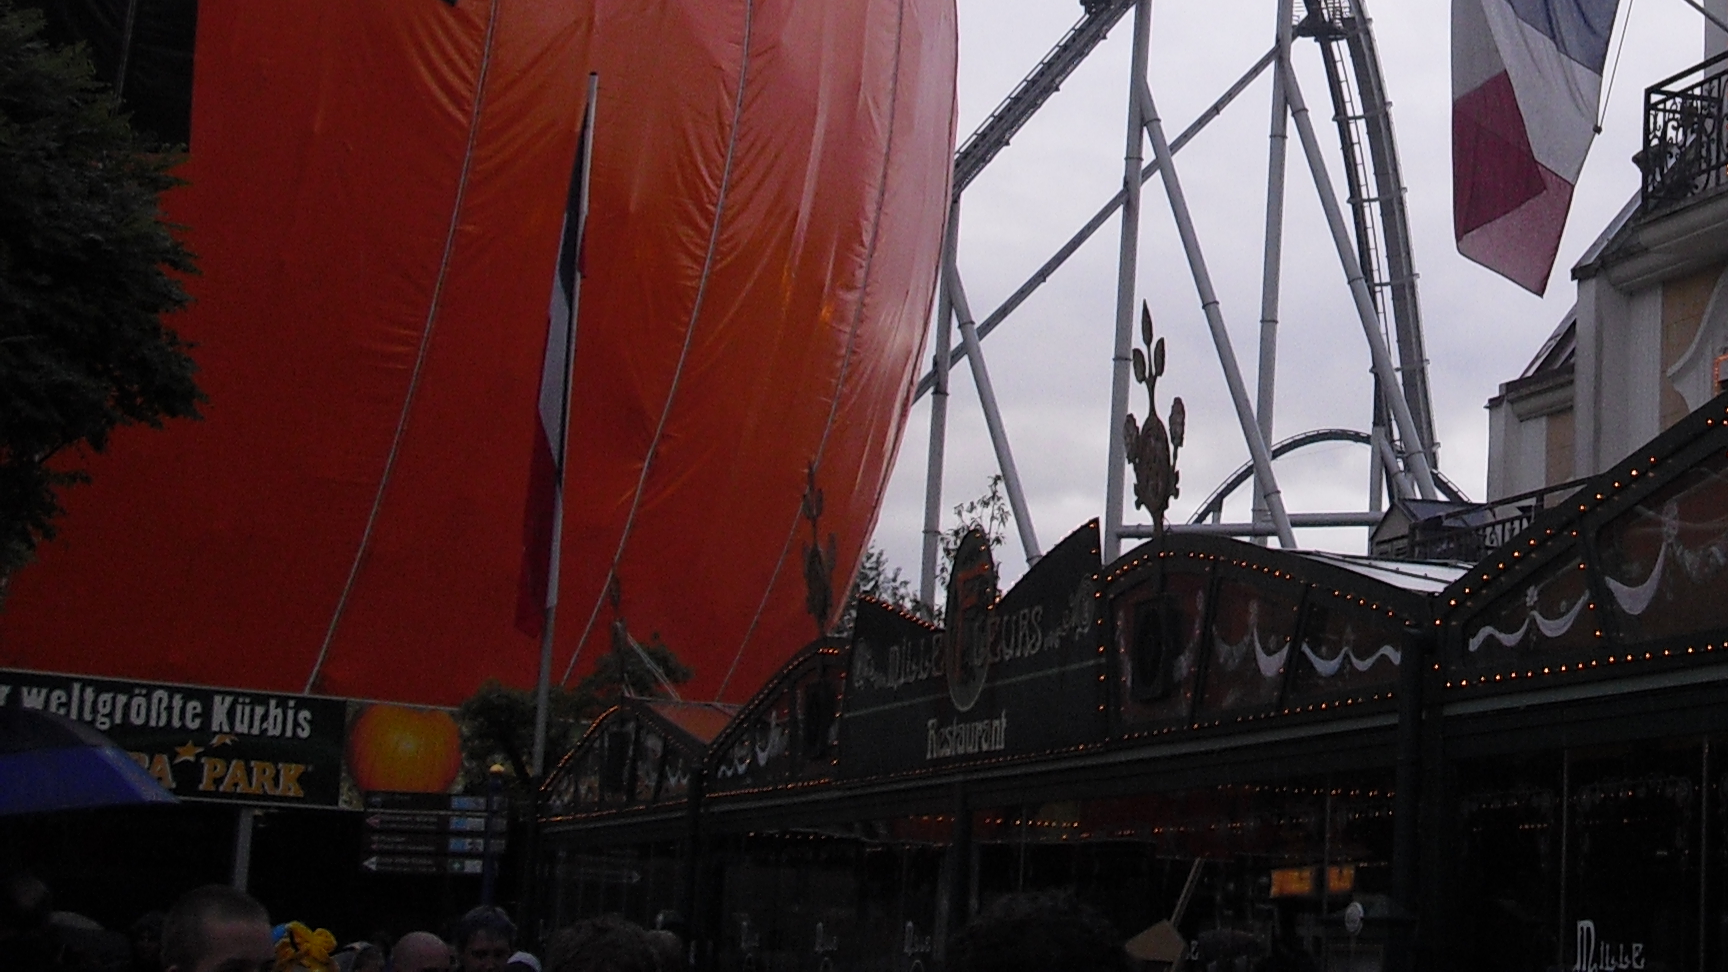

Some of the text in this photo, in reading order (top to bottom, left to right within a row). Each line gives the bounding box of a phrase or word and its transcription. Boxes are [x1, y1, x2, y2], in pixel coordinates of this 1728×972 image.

[20, 681, 202, 731] weltgrößte
[210, 693, 313, 740] Kürbis
[925, 708, 1007, 760] Restaurant
[199, 756, 306, 798] PARK
